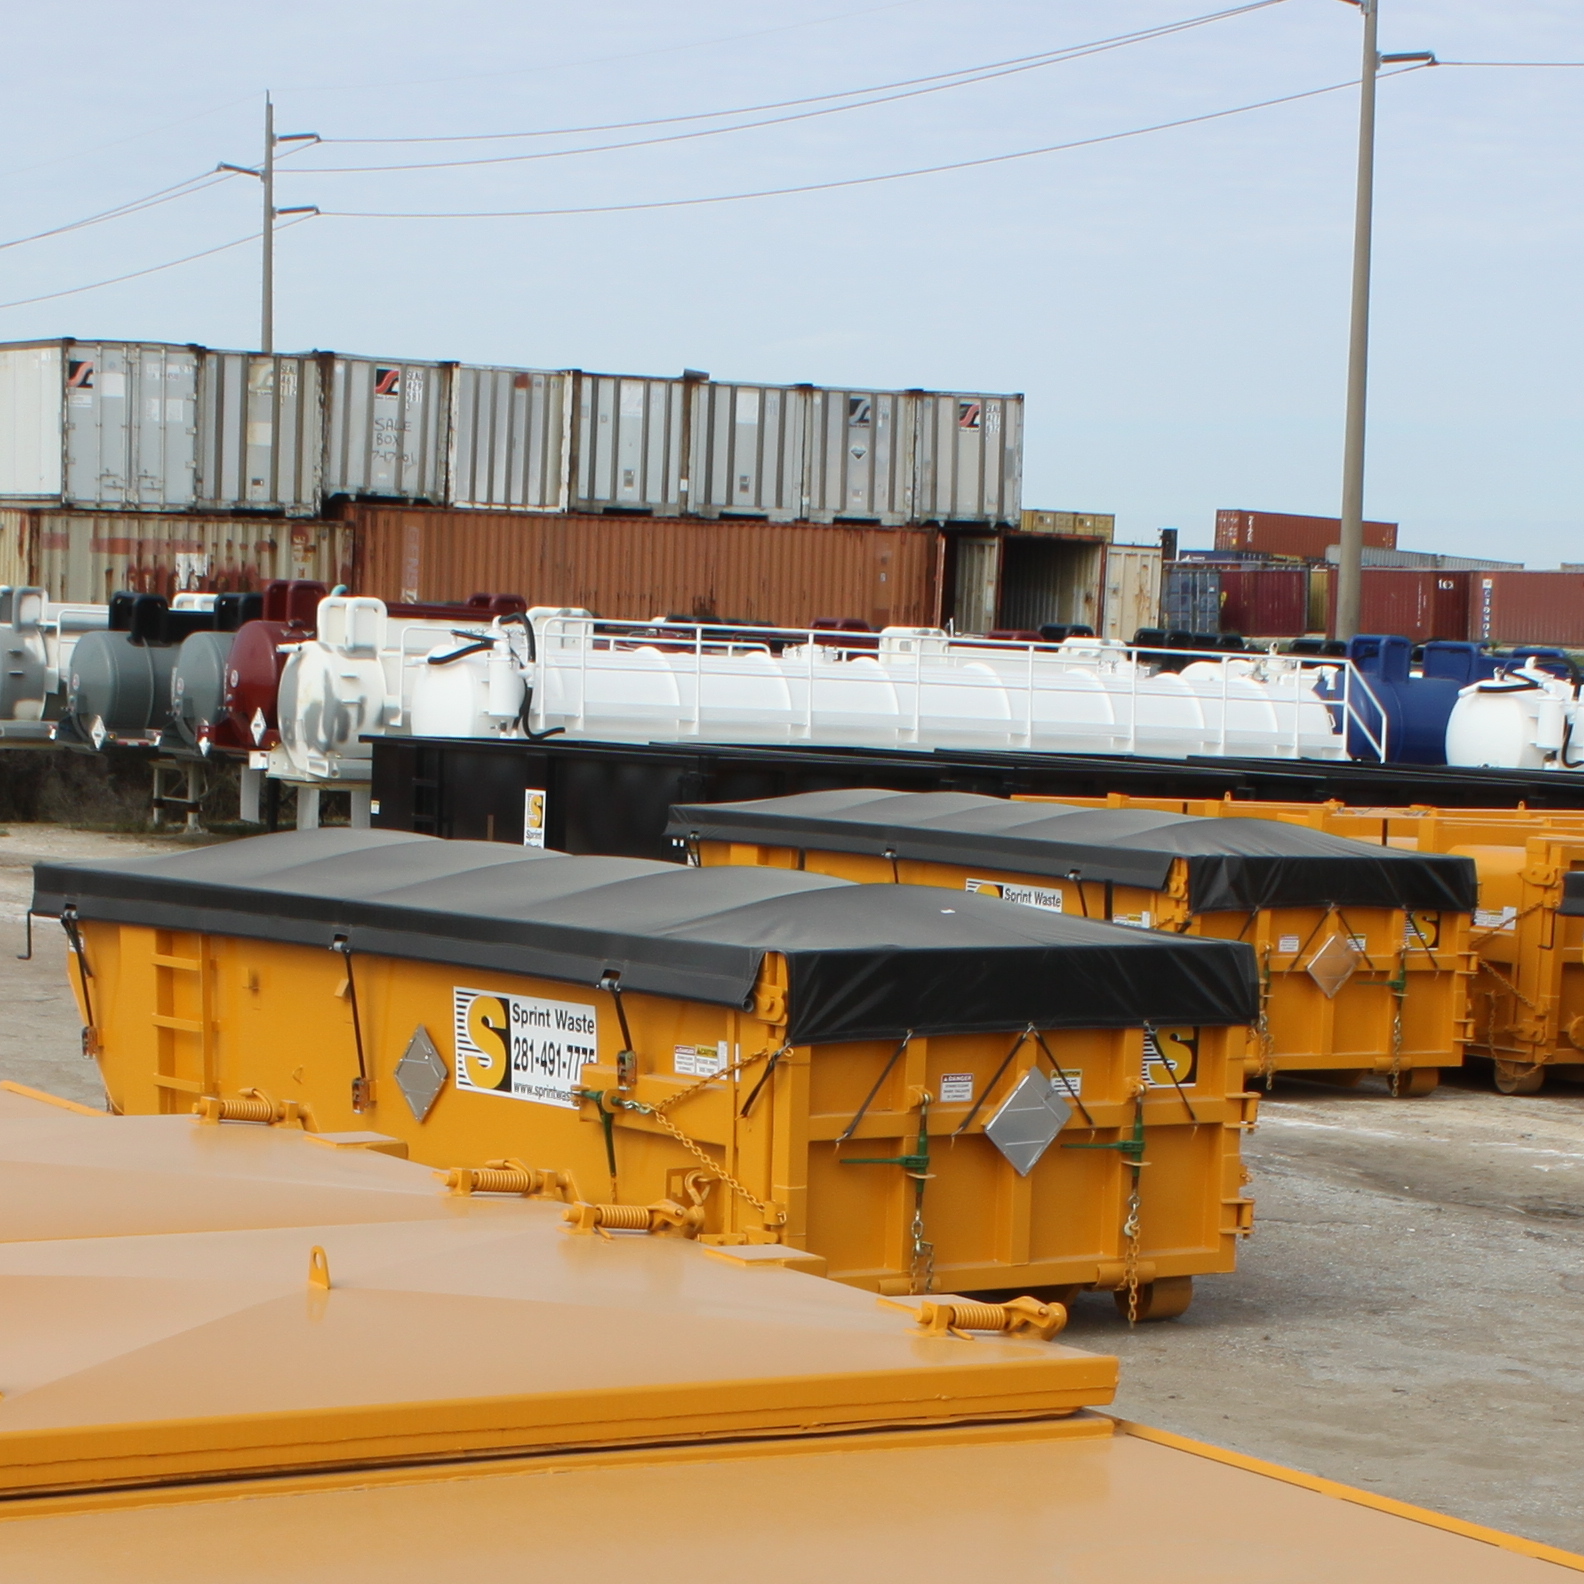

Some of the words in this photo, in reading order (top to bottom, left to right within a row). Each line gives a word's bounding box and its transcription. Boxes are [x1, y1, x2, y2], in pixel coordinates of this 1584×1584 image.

[374, 418, 413, 432] SALE
[376, 433, 400, 446] BOX
[1004, 887, 1032, 903] Sprint
[1034, 891, 1061, 908] Waste
[512, 1002, 551, 1029] Sprint
[554, 1009, 595, 1034] Waste
[514, 1081, 574, 1102] www.sprintwas
